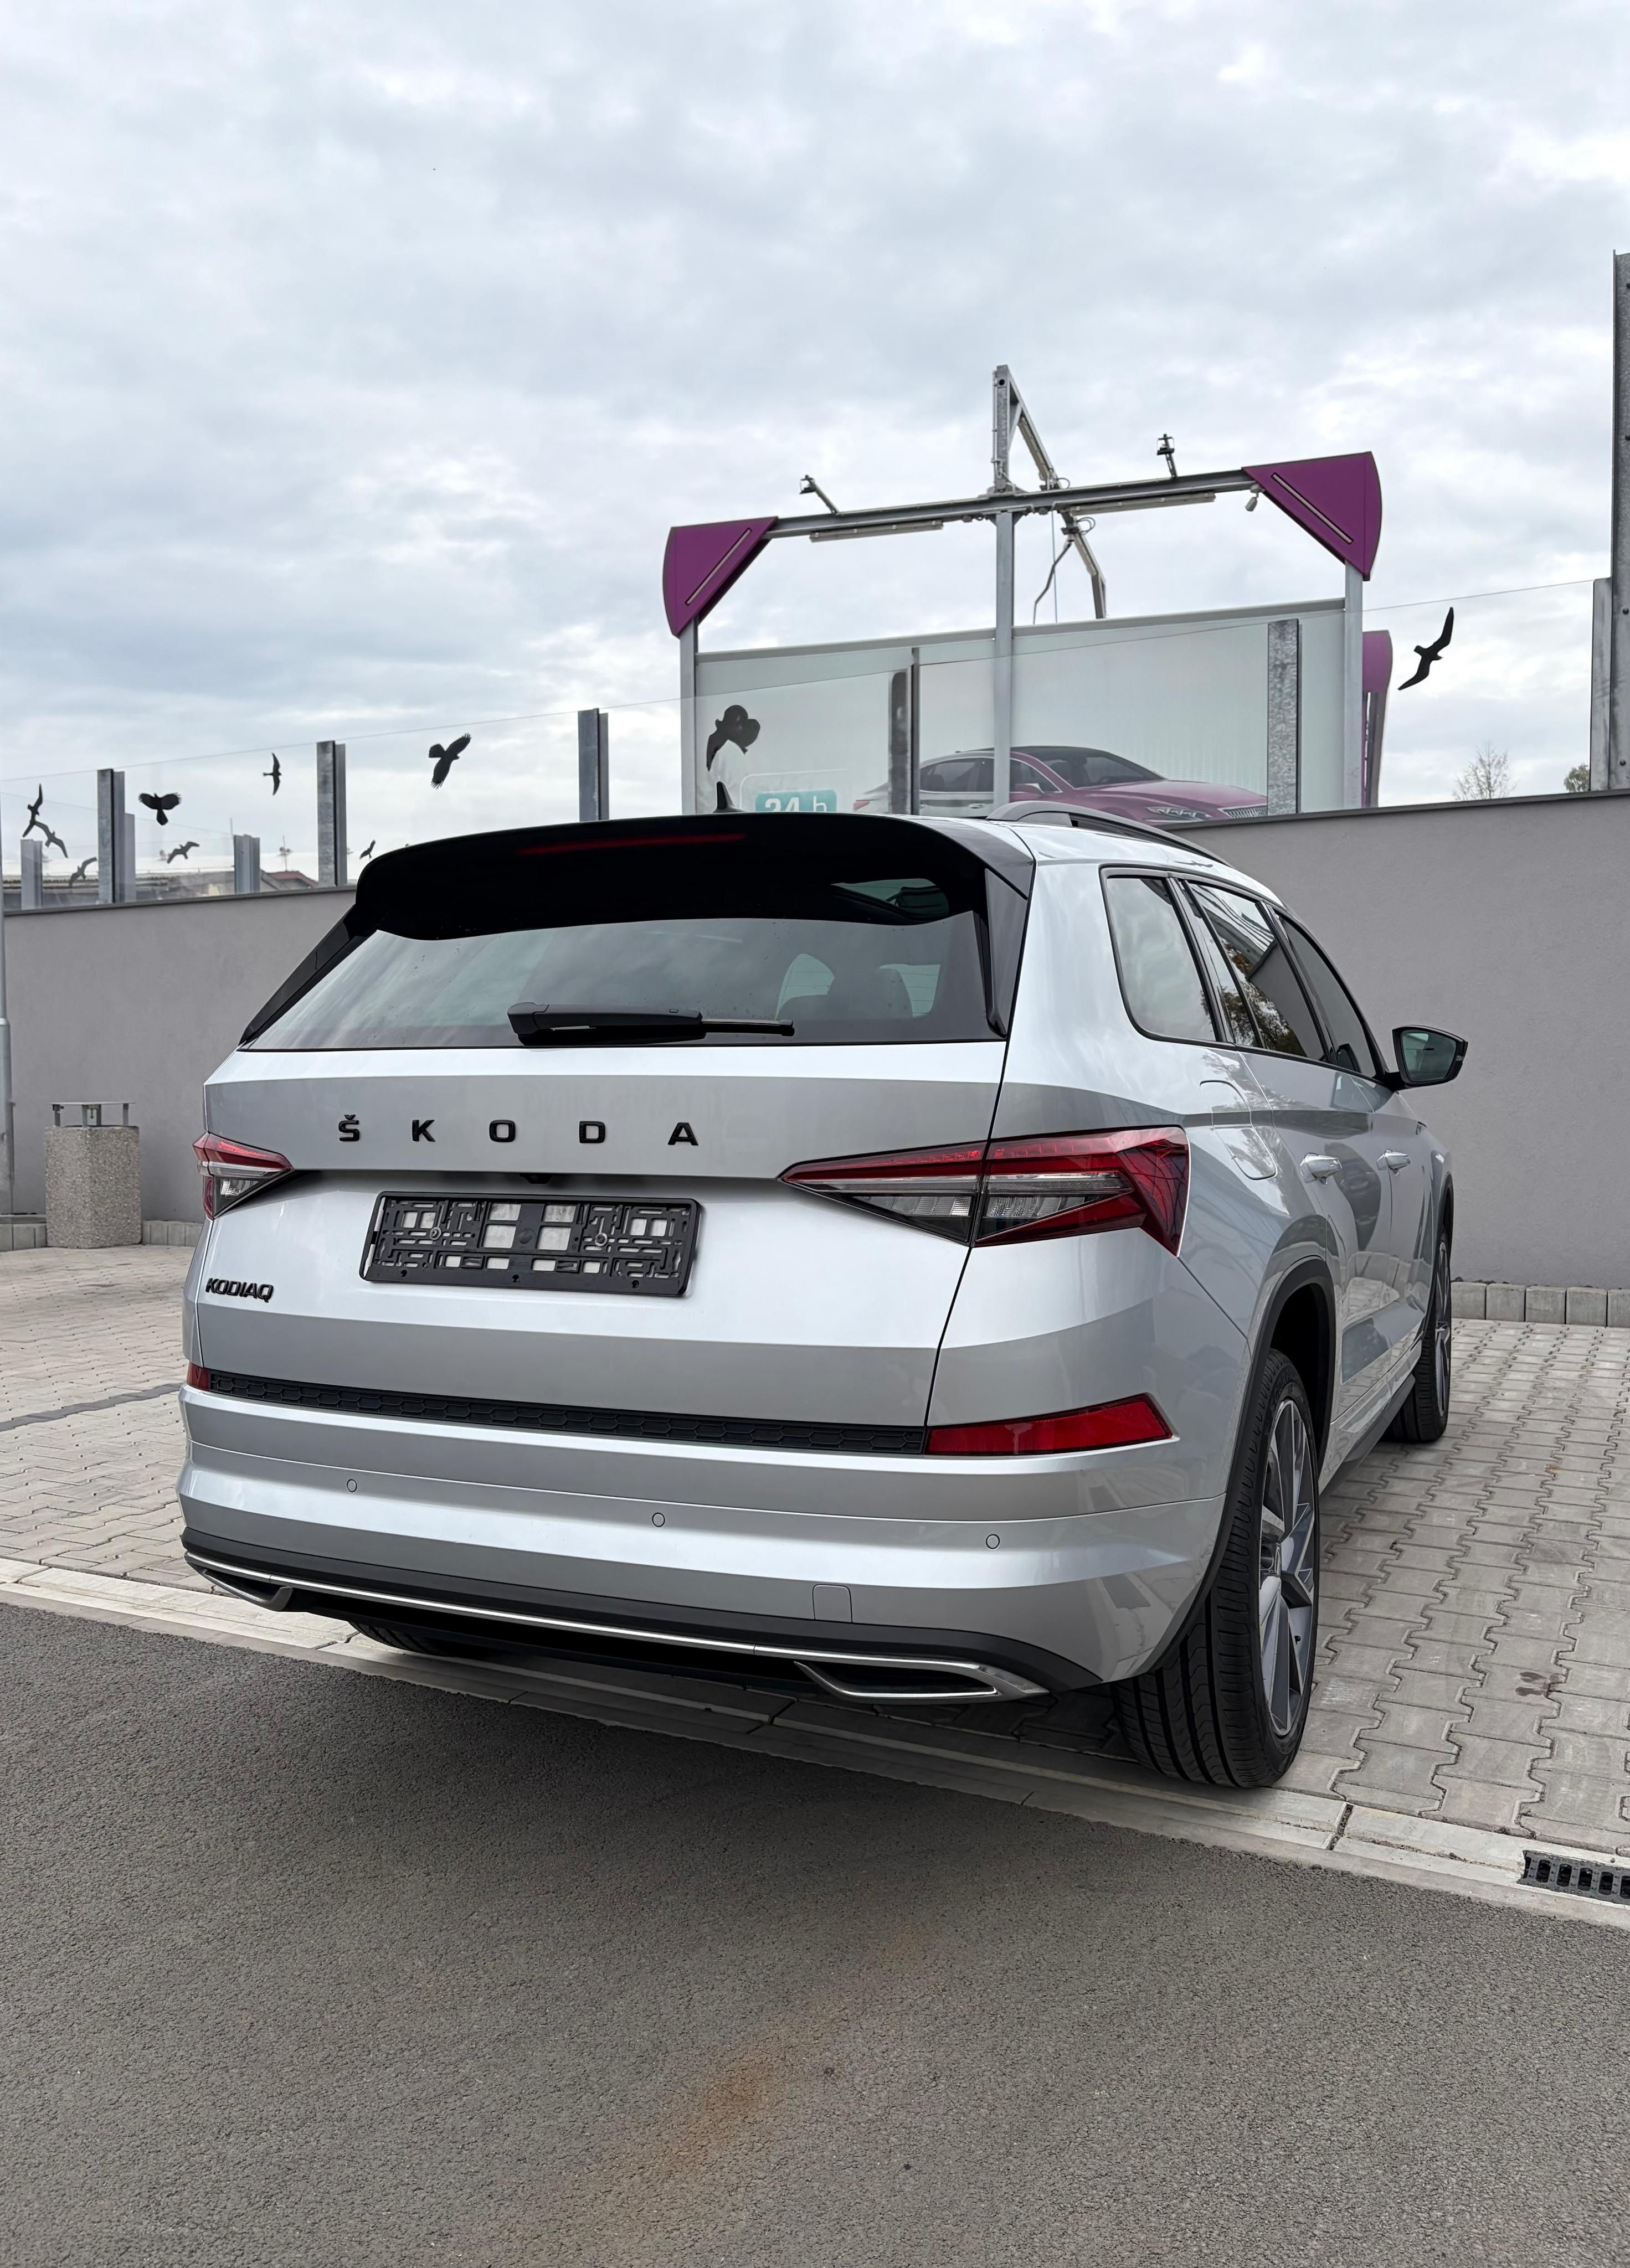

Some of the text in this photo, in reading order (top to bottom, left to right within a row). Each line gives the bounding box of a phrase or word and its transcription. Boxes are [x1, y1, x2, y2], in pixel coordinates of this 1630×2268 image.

[765, 796, 827, 812] 24 h
[338, 1114, 698, 1146] ŠKODA
[205, 1278, 274, 1303] KODIAQ
